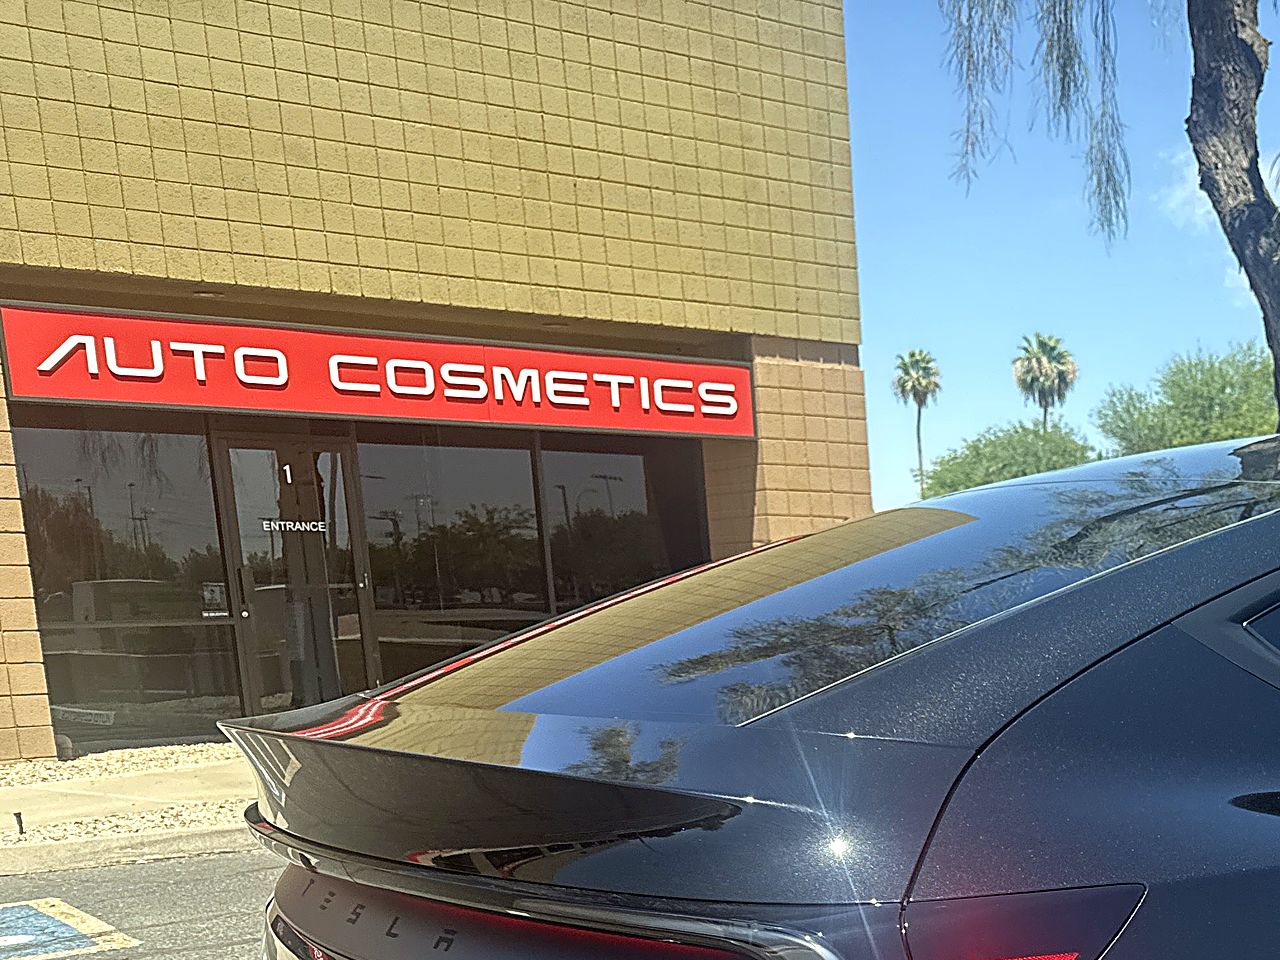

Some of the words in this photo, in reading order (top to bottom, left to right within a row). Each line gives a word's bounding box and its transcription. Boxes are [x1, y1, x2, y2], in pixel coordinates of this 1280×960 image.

[37, 334, 290, 387] AUTO
[328, 354, 739, 417] COSMETICS
[282, 464, 293, 484] 1
[262, 520, 327, 532] ENTRANCE
[302, 878, 458, 952] TESLA
